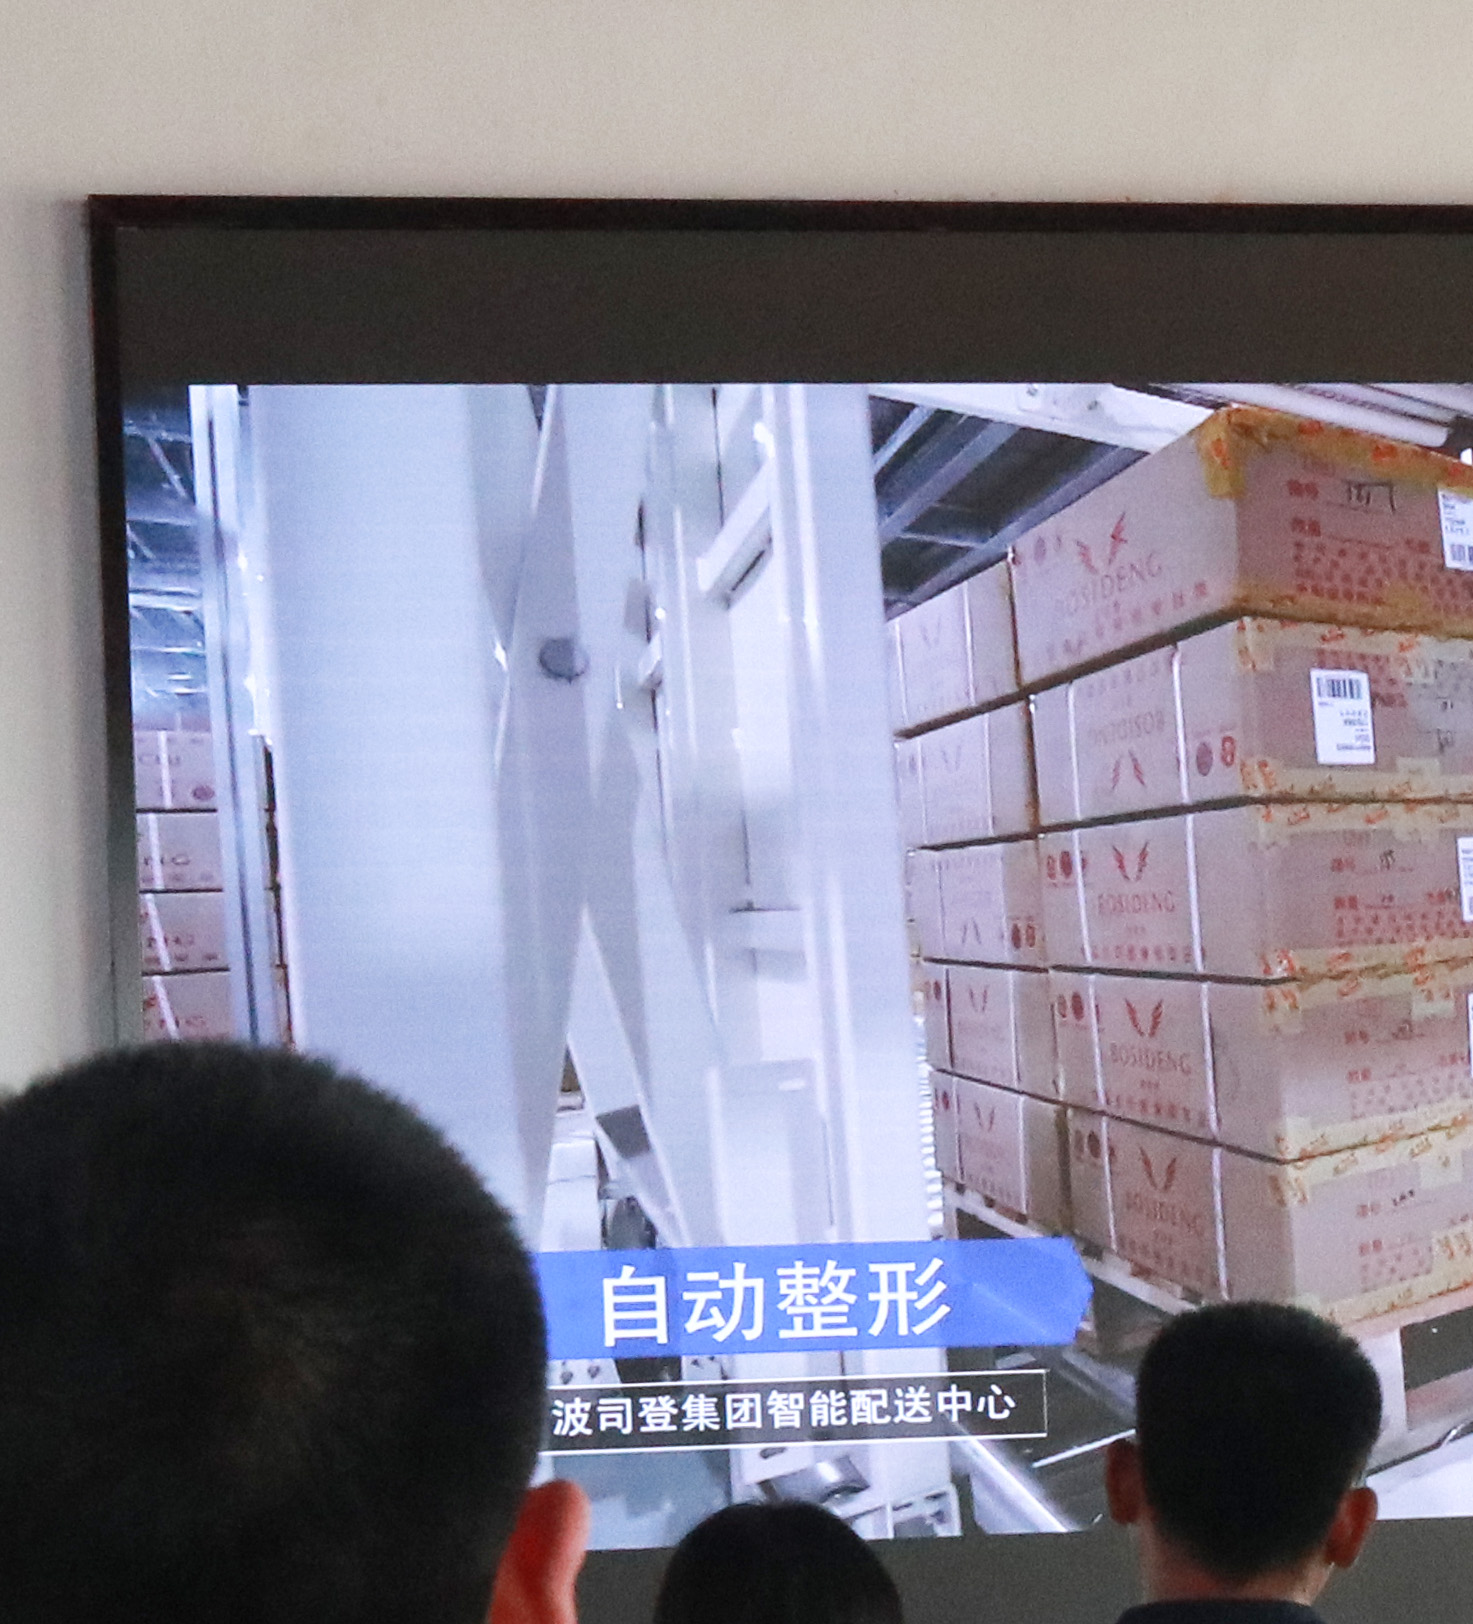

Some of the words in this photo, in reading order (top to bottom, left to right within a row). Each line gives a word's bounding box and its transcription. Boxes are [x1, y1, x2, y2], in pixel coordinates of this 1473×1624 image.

[601, 1256, 952, 1347] 自动整形
[550, 1383, 1017, 1437] 波司登集团智能配送中心
